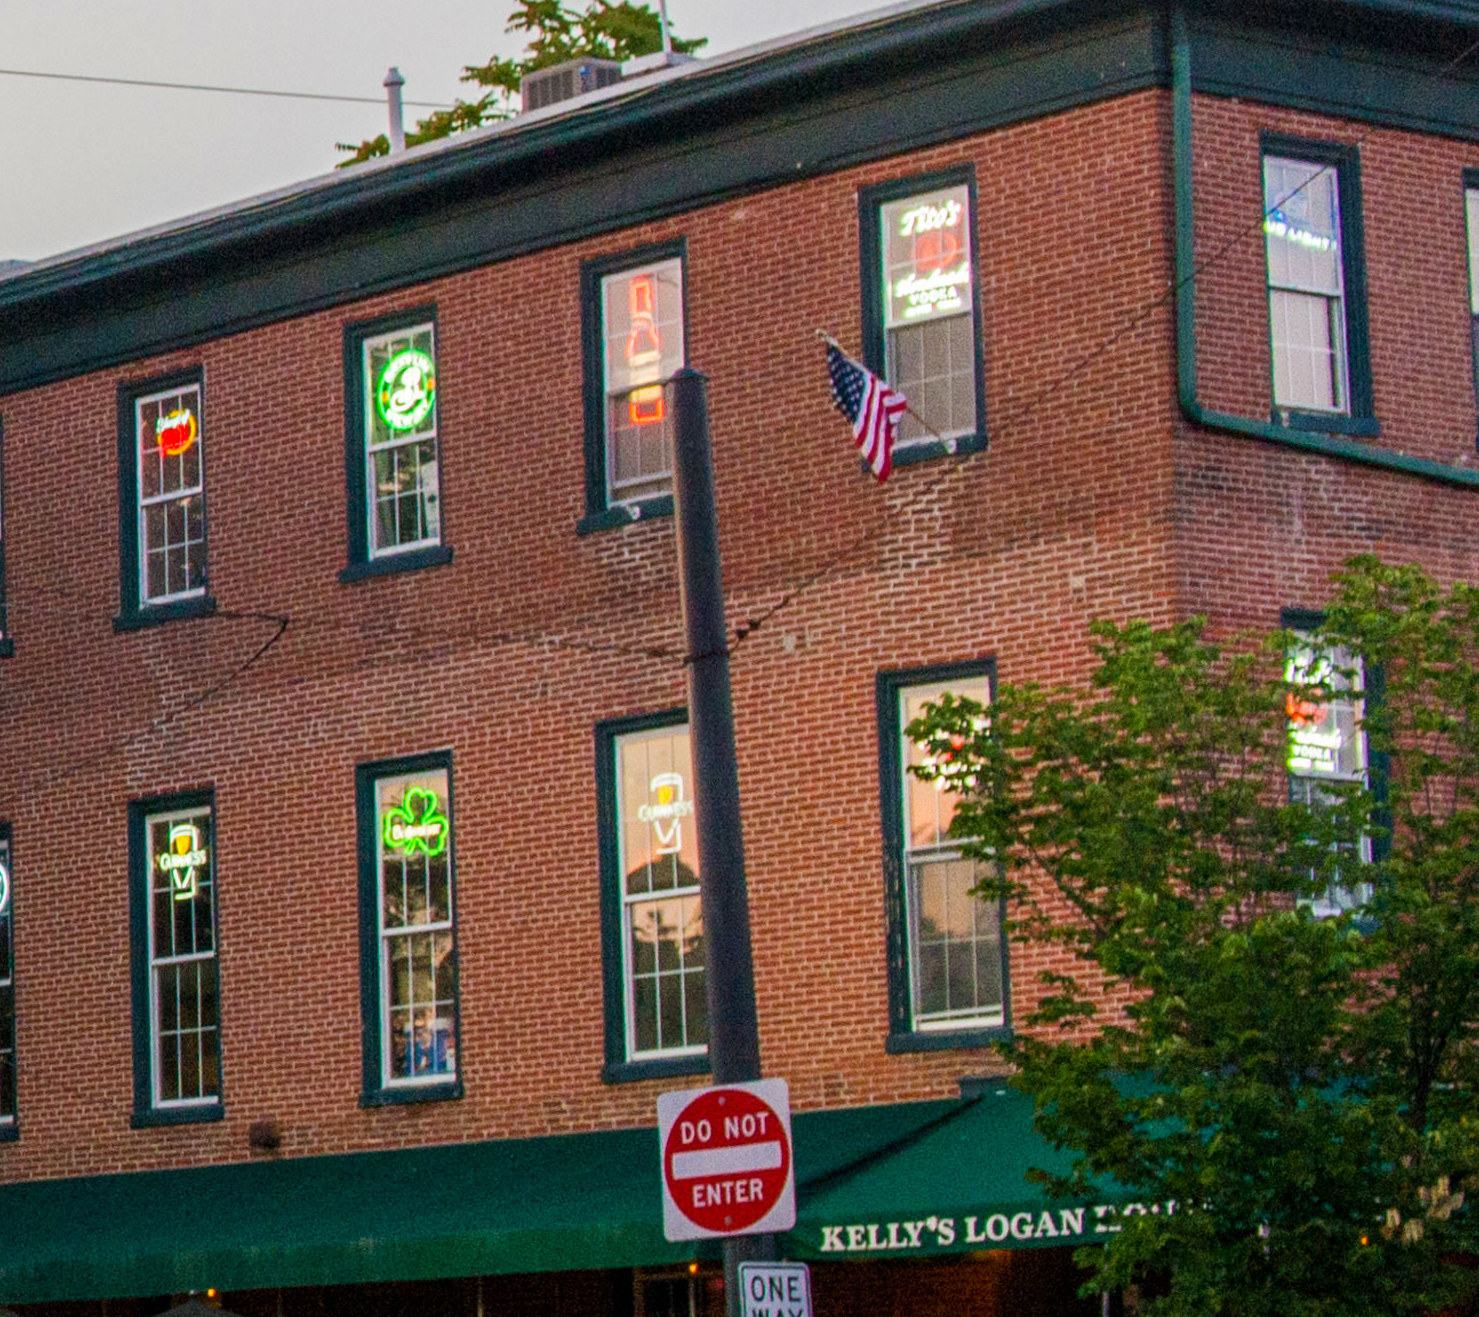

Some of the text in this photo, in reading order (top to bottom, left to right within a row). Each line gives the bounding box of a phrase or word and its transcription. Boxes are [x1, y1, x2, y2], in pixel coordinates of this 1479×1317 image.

[900, 199, 962, 236] Tito's
[680, 1112, 769, 1144] DO NOT
[692, 1178, 764, 1208] ENTER
[820, 1215, 956, 1252] KELLY'S
[966, 1207, 1085, 1244] LOGAN
[751, 1275, 802, 1302] ONE
